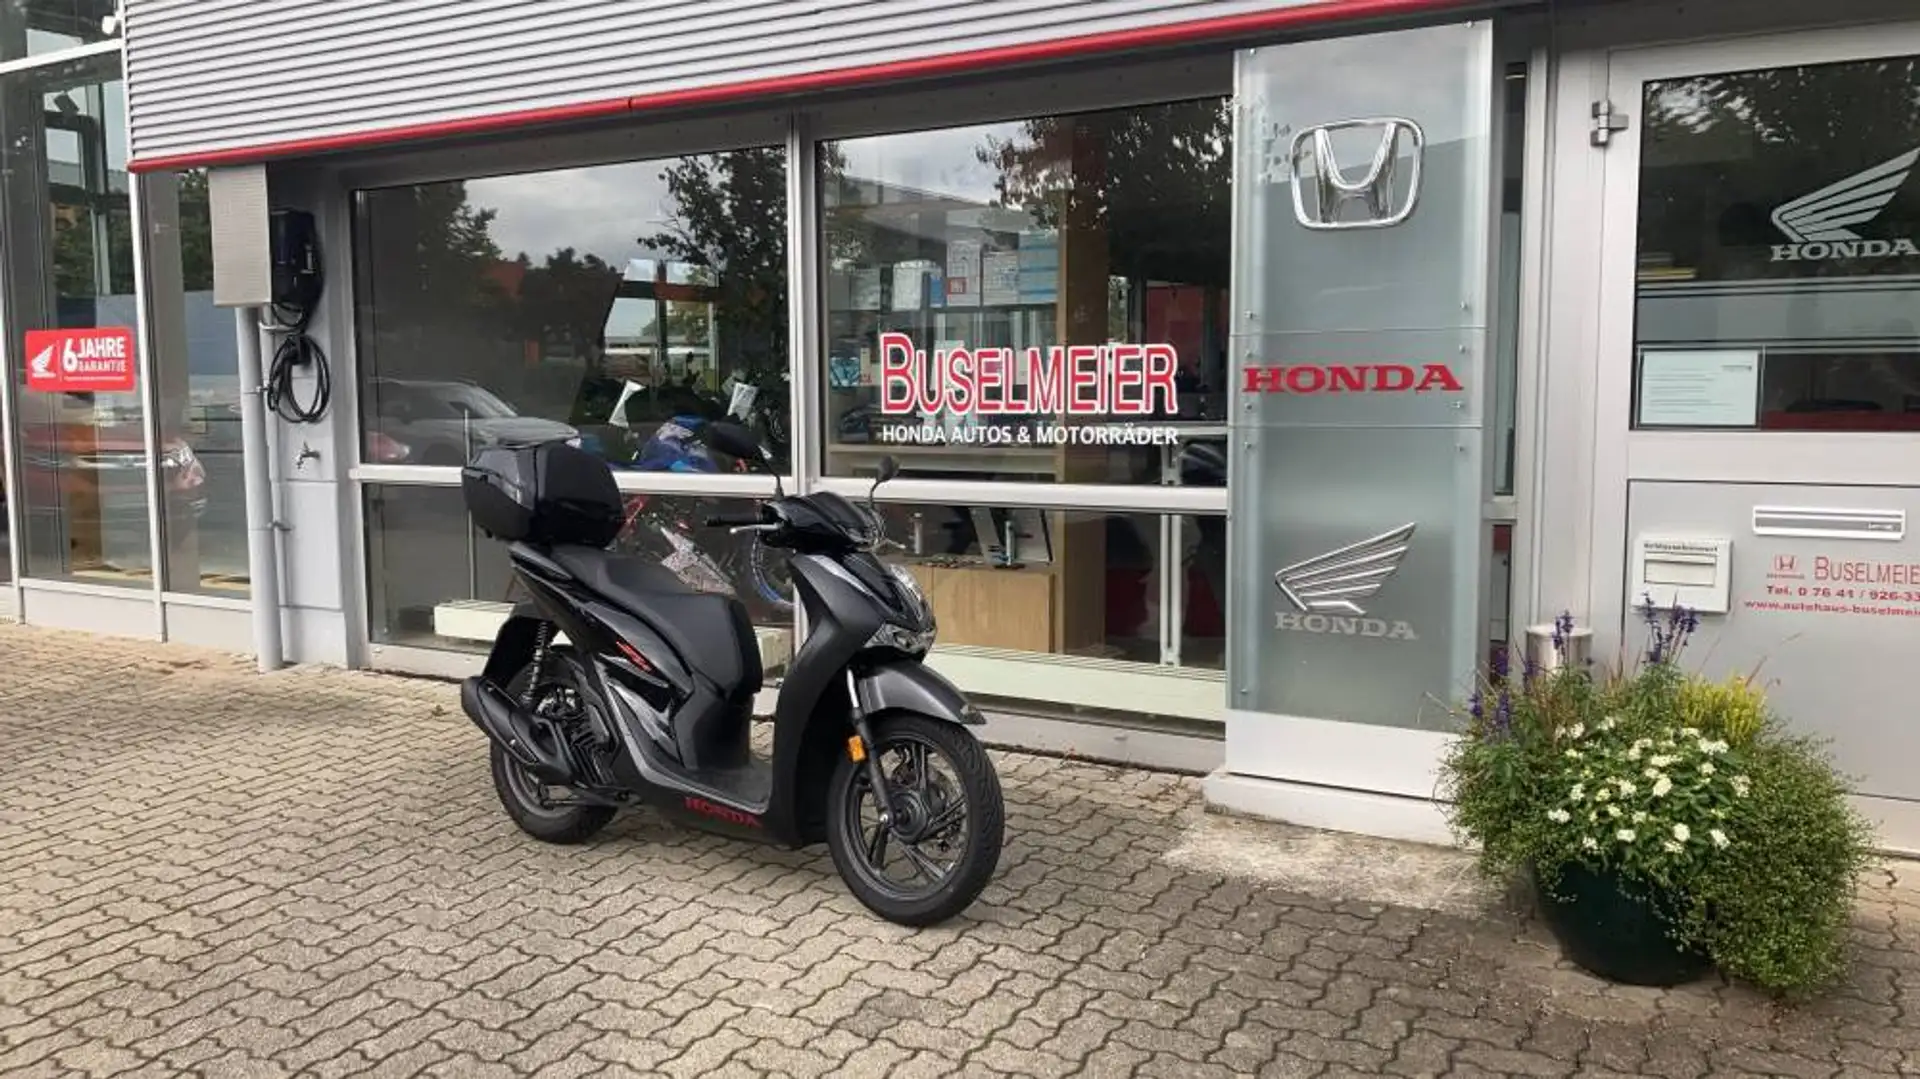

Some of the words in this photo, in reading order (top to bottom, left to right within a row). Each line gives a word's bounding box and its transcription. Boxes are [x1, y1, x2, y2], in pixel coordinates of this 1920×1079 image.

[1770, 238, 1920, 262] HONDA
[62, 338, 78, 372] 6
[78, 336, 126, 358] JAHRE
[880, 333, 1178, 415] BUSELMEIER
[1243, 364, 1464, 394] HONDA
[882, 425, 946, 444] HONDA
[951, 425, 1012, 444] AUTOS
[1017, 425, 1031, 444] &
[1036, 422, 1179, 446] MOTORRÄDER
[1766, 585, 1792, 596] Tel.
[1812, 587, 1831, 597] 76
[1836, 588, 1854, 598] 41
[1274, 612, 1418, 641] HONDA
[684, 797, 764, 828] HONDA
